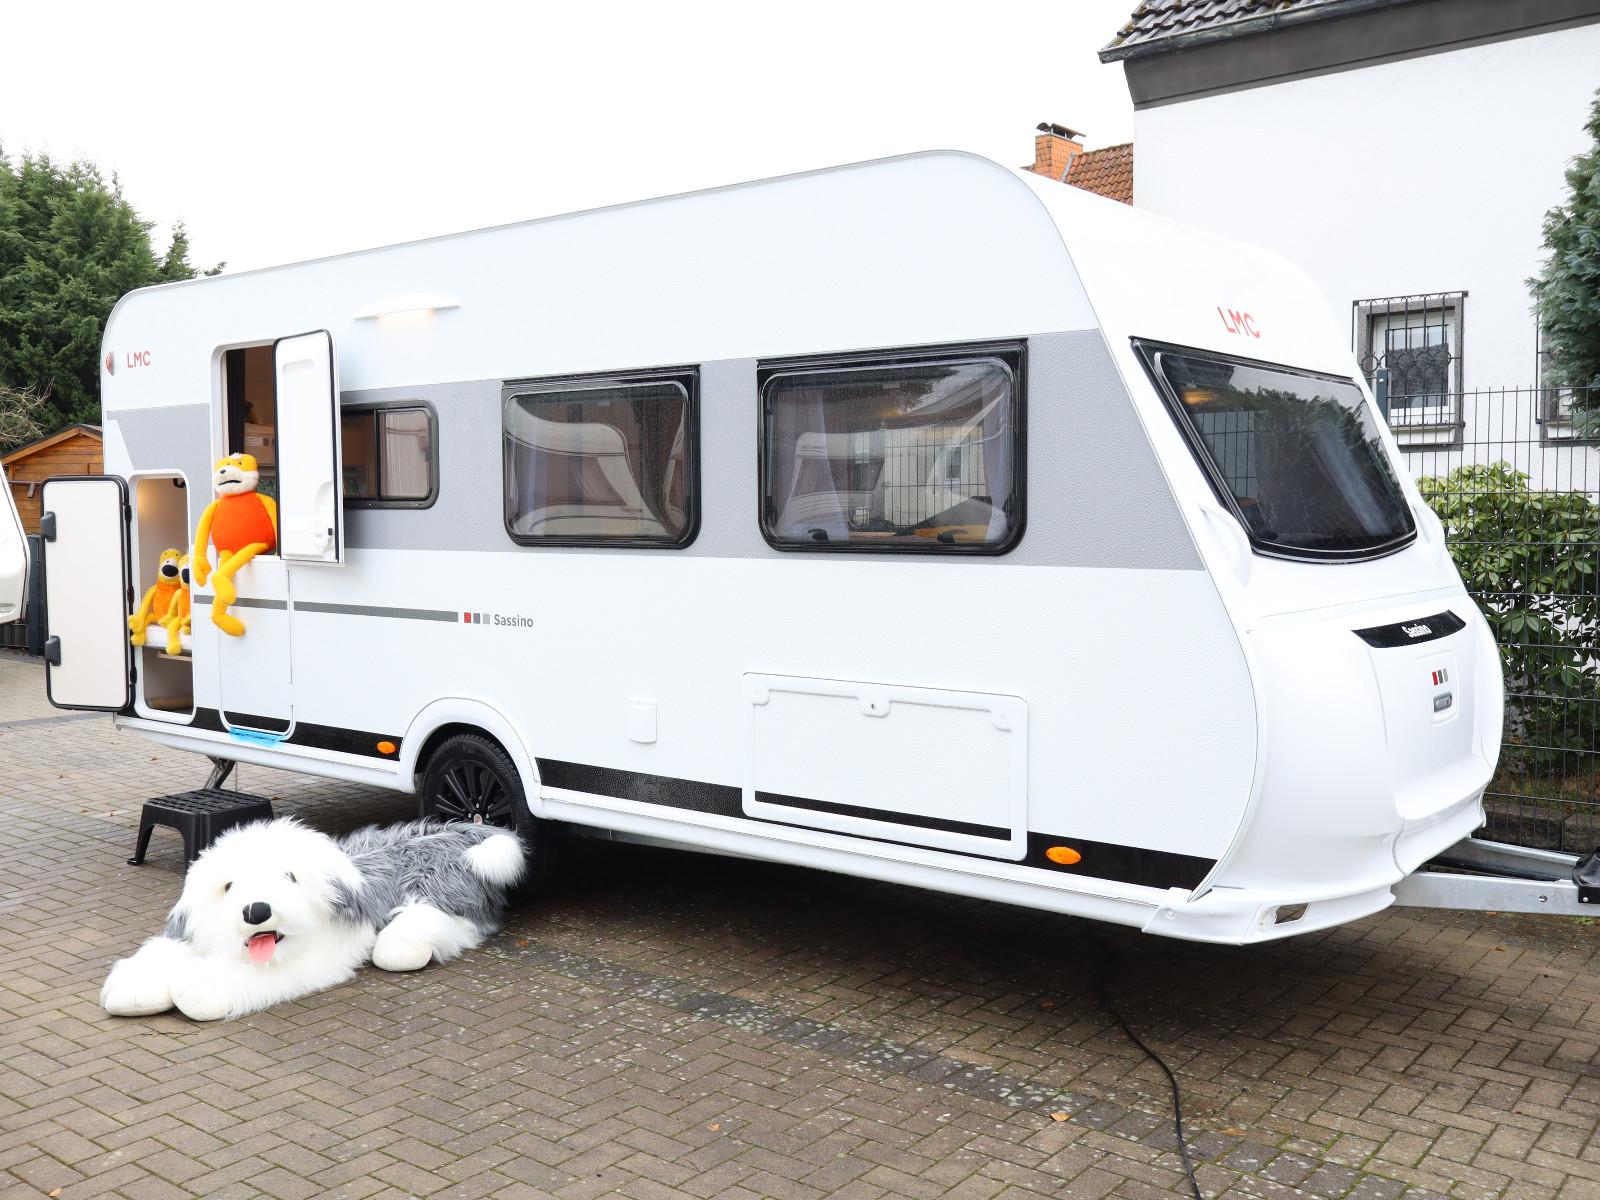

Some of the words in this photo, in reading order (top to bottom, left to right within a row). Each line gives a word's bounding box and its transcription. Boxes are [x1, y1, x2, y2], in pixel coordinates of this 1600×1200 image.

[1217, 306, 1260, 338] LMC
[127, 350, 151, 368] LMC
[494, 613, 534, 628] Sassino
